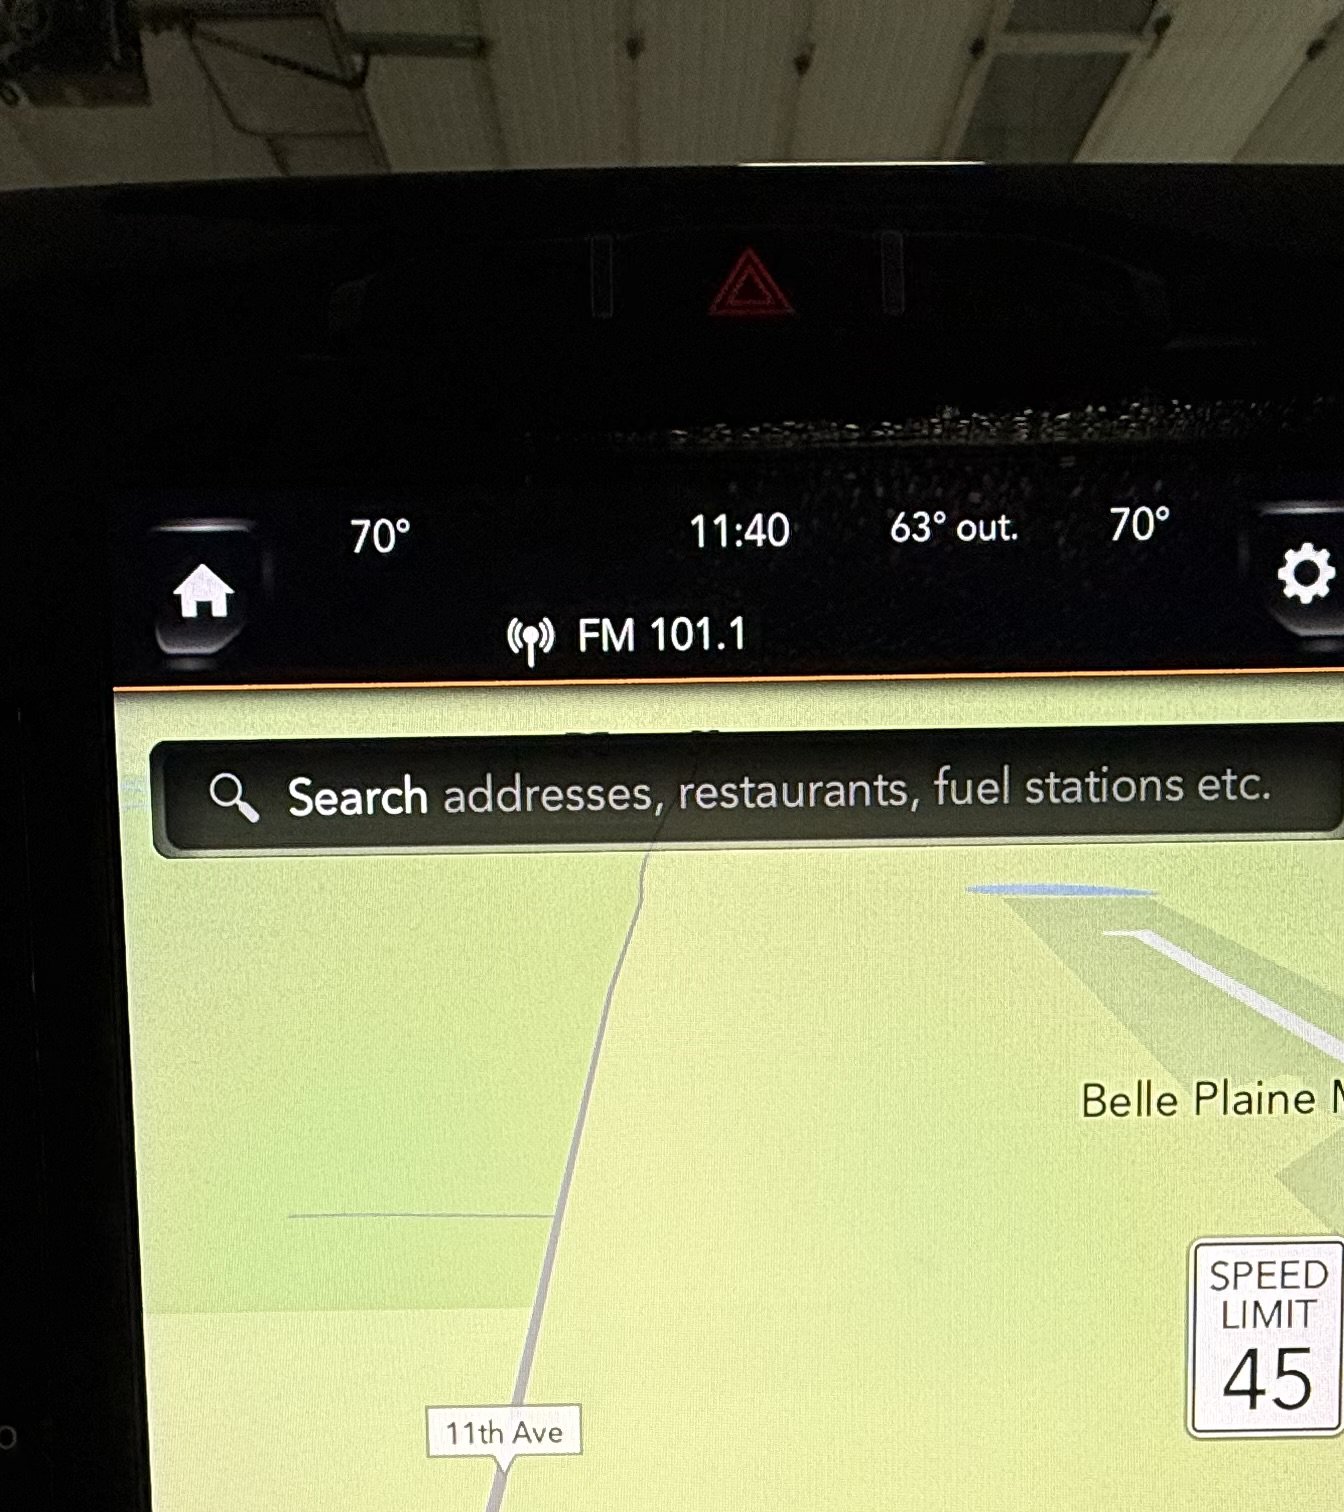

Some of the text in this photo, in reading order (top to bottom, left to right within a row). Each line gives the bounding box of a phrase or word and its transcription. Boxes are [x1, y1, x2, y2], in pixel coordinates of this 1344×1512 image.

[350, 516, 411, 554] 70°
[689, 511, 791, 548] 11:40
[889, 510, 1019, 543] 63° out.
[1109, 505, 1171, 541] 70°
[578, 615, 746, 653] FM 101.1
[288, 764, 1272, 817] Search addresses, restaurants, fuel stations etc.
[1082, 1079, 1179, 1118] Belle
[1194, 1077, 1317, 1116] Plaine
[1209, 1259, 1330, 1292] SPEED
[1221, 1299, 1318, 1330] LIMIT
[1222, 1346, 1313, 1411] 45
[446, 1418, 564, 1446] 11th Ave
